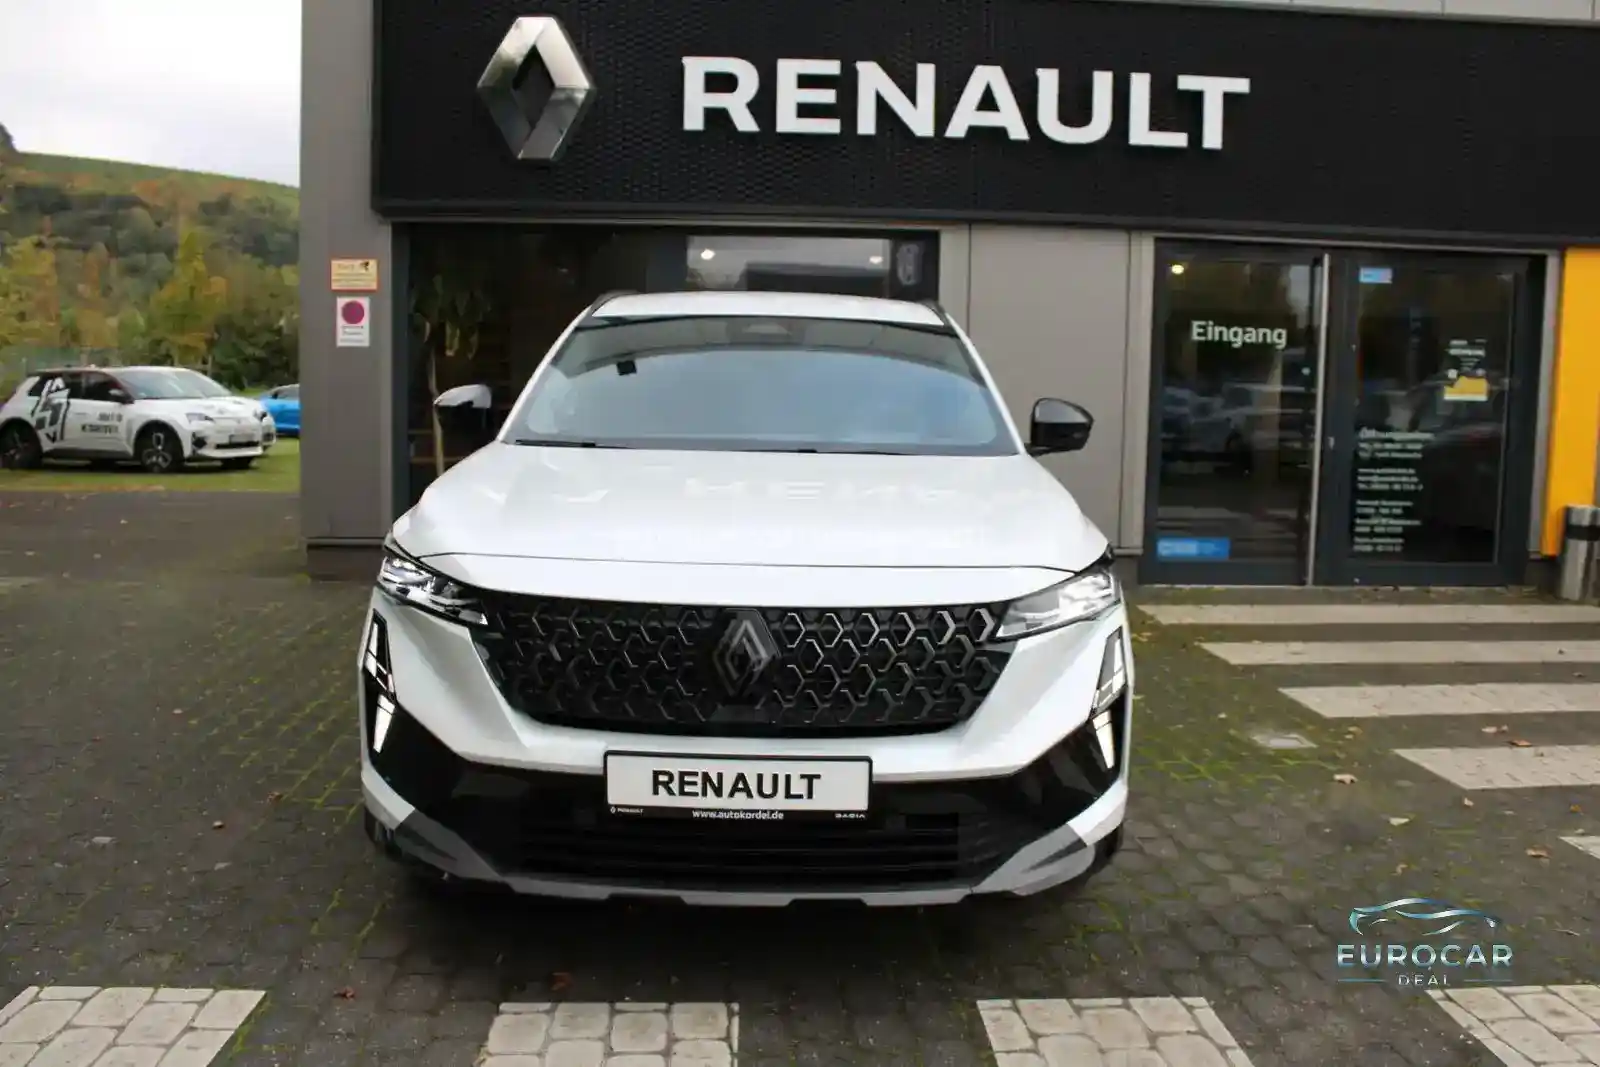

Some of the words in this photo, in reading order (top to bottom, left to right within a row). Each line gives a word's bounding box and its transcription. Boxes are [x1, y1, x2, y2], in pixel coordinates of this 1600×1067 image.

[681, 55, 1251, 150] RENAULT
[1191, 319, 1288, 350] Eingang
[651, 769, 822, 800] RENAULT
[692, 809, 785, 821] www.autokordel.de
